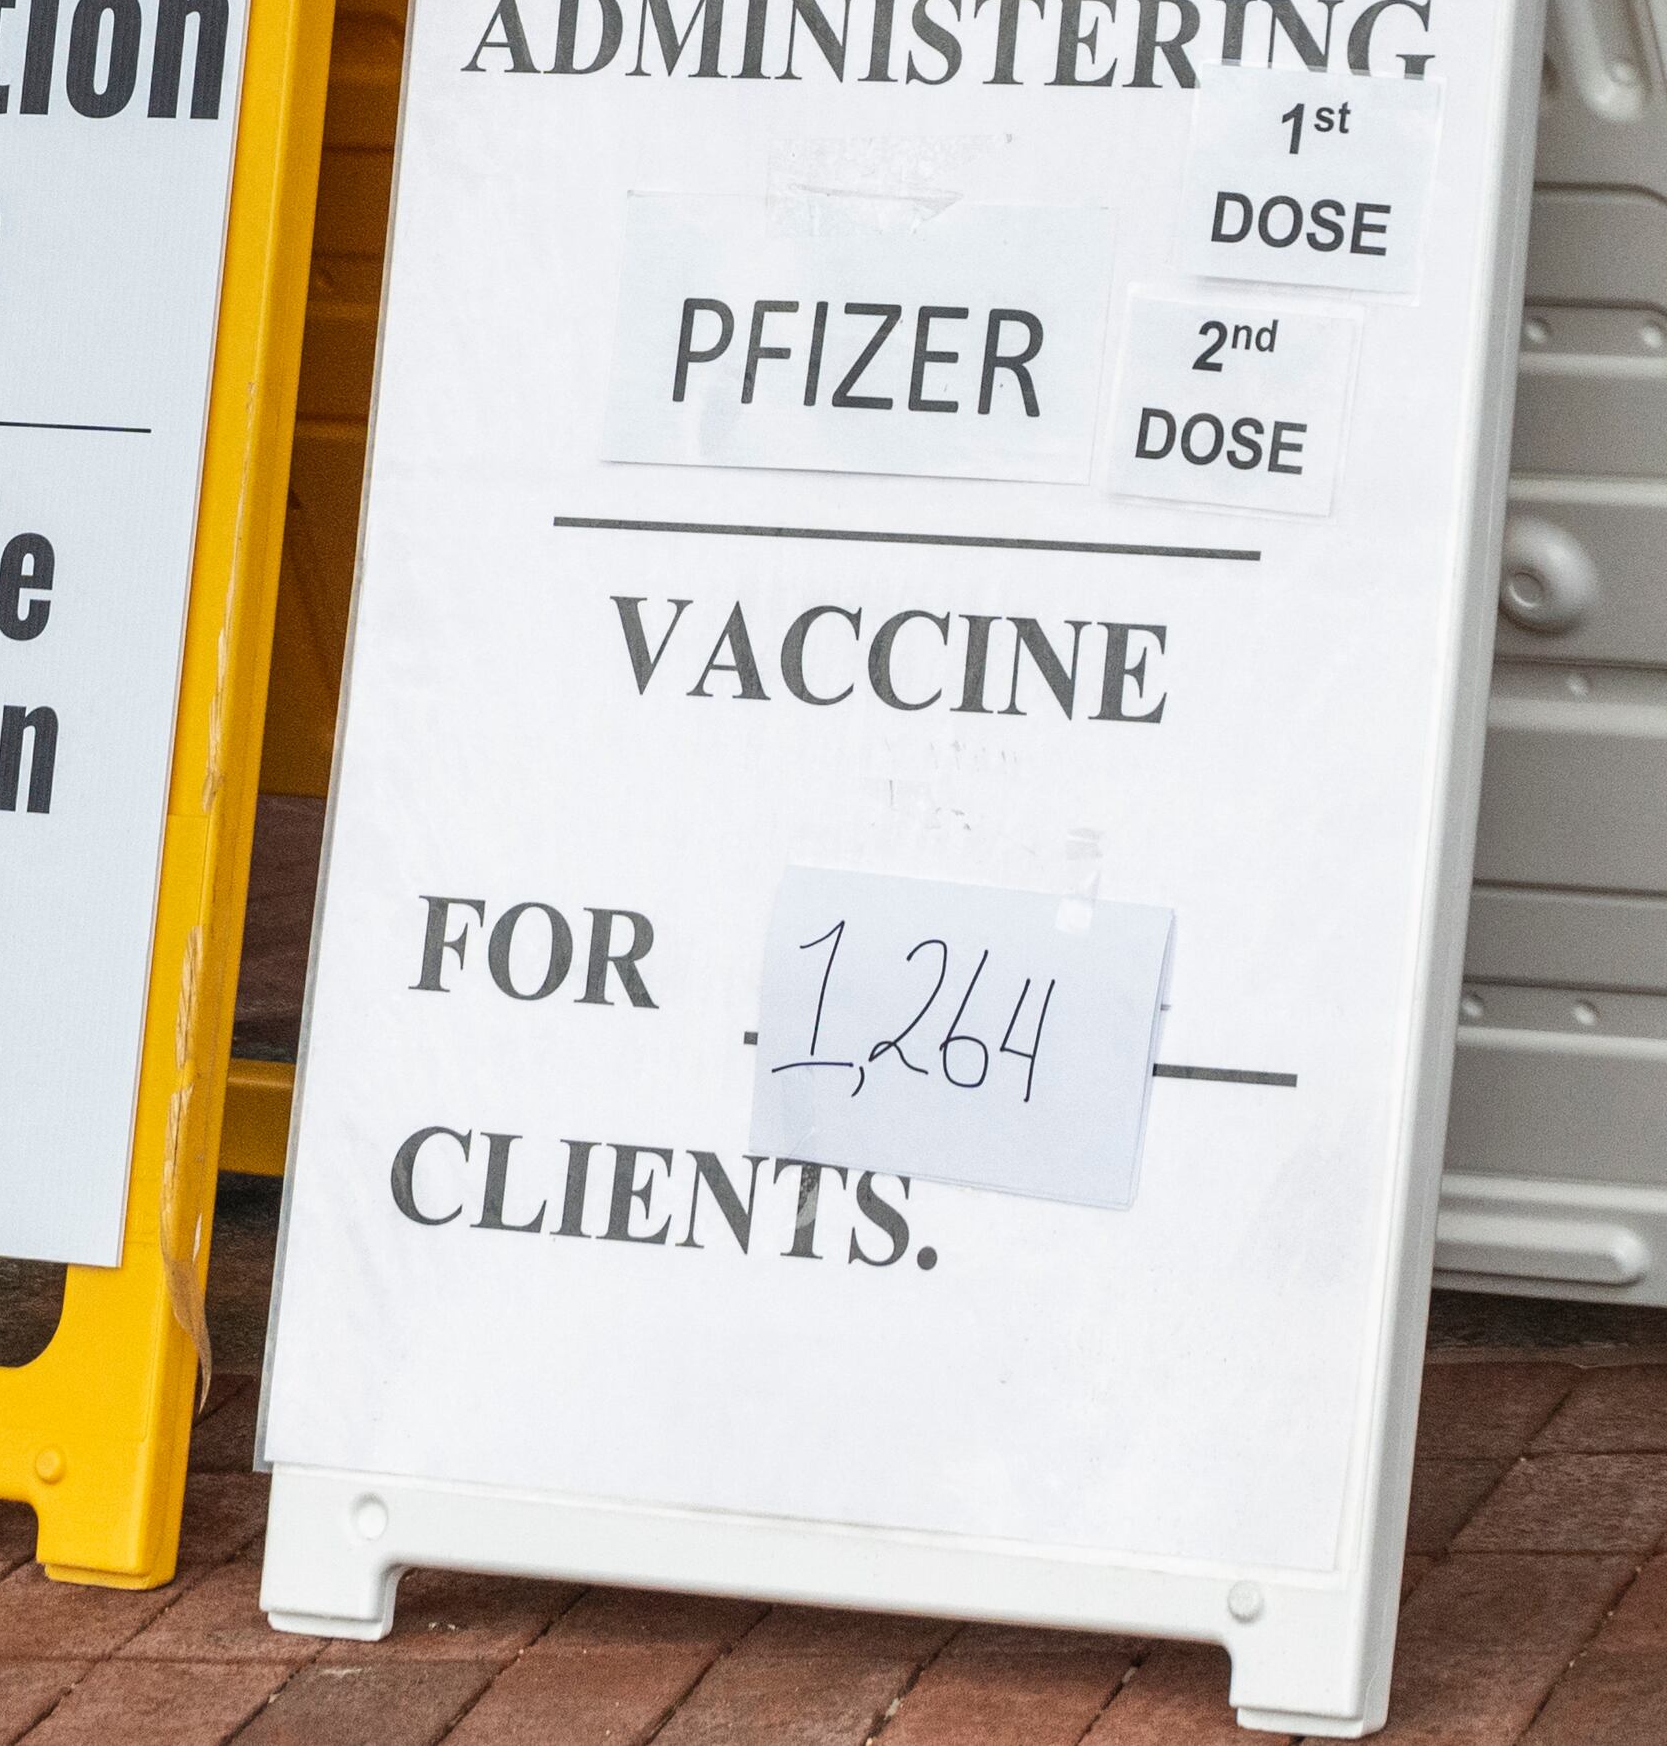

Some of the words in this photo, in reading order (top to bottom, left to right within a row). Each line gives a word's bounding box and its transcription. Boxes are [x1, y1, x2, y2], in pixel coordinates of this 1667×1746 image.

[1281, 102, 1352, 155] 1st
[1211, 191, 1391, 256] DOSE
[672, 298, 1045, 418] PFIZER
[1192, 319, 1279, 372] 2nd
[1135, 407, 1307, 475] DOSE
[610, 596, 1168, 725] VACCINE
[408, 895, 660, 1009] FOR
[771, 920, 1056, 1103] 1,264
[390, 1126, 939, 1271] CLIENTS.
